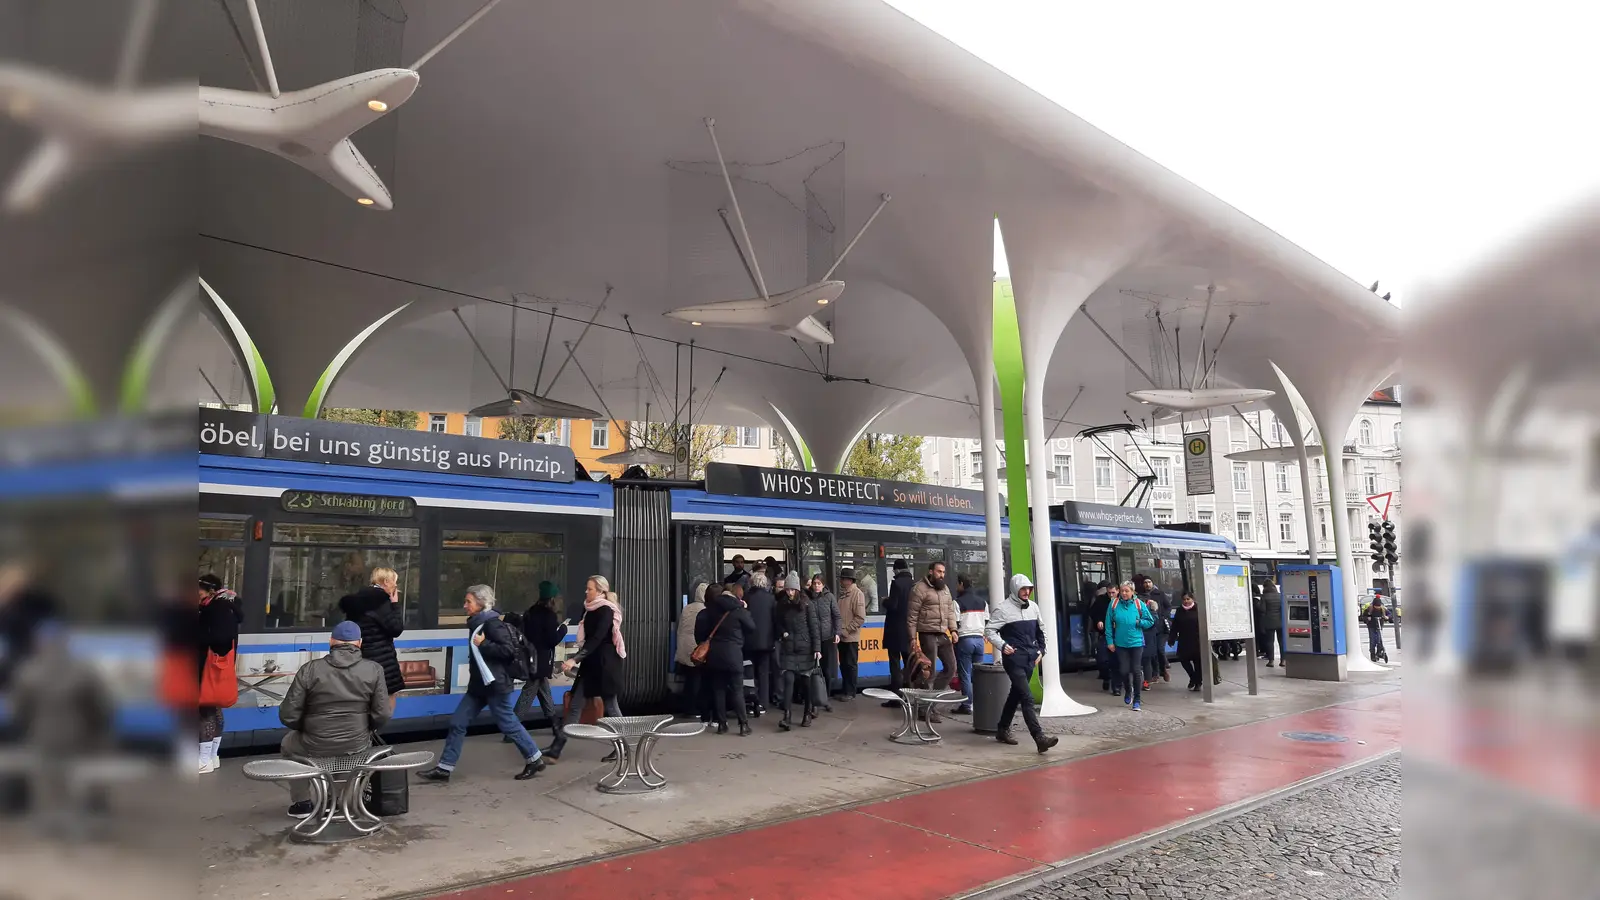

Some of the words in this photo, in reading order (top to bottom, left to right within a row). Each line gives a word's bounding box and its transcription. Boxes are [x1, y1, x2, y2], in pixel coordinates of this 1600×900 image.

[200, 423, 263, 451] öbel,
[273, 428, 309, 452] bei
[319, 439, 361, 456] uns
[367, 441, 451, 470] günstig
[457, 451, 491, 468] aus
[499, 451, 565, 479] Prinzip.
[761, 473, 813, 495] WHO'S
[818, 478, 884, 501] PERFECT.
[287, 493, 312, 508] 23
[320, 493, 376, 512] Schwabing
[380, 498, 405, 511] Nord
[893, 488, 906, 503] So
[908, 490, 927, 505] will
[929, 492, 944, 507] ich
[946, 493, 974, 509] leben.
[1078, 509, 1144, 525] www.whos-perfect.de
